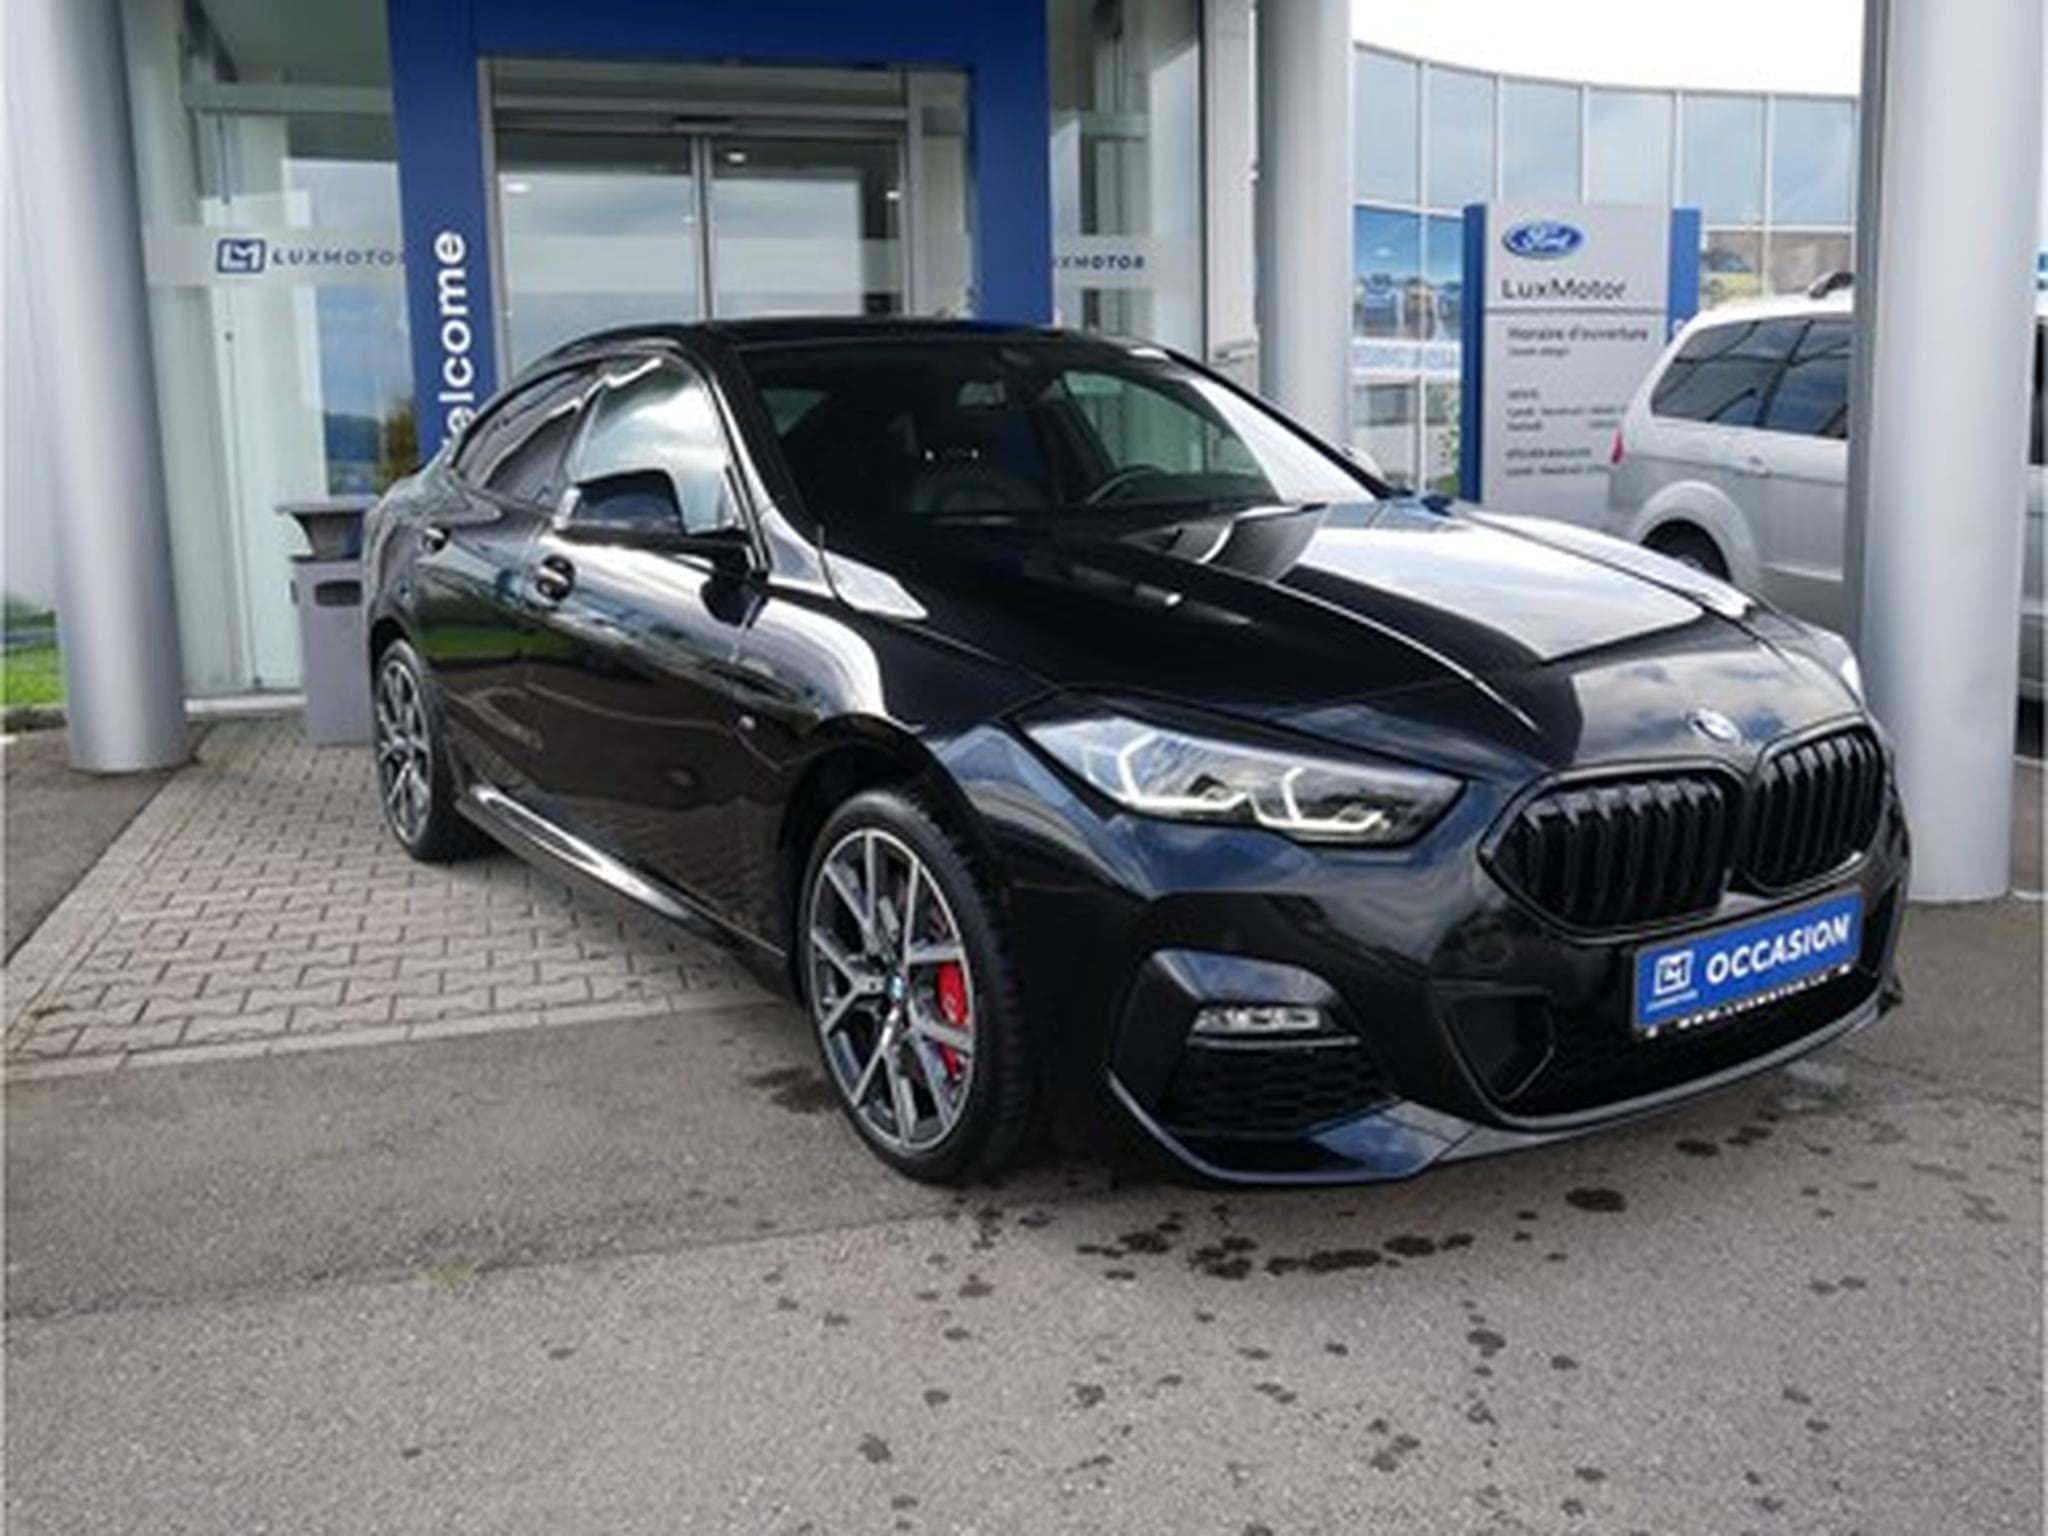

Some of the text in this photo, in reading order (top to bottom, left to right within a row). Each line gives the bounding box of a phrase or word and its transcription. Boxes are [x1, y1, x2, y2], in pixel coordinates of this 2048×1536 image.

[1506, 223, 1577, 253] Ford
[1502, 279, 1626, 300] LuxMotor
[434, 231, 475, 448] elcome
[1705, 914, 1850, 984] OCCASION
